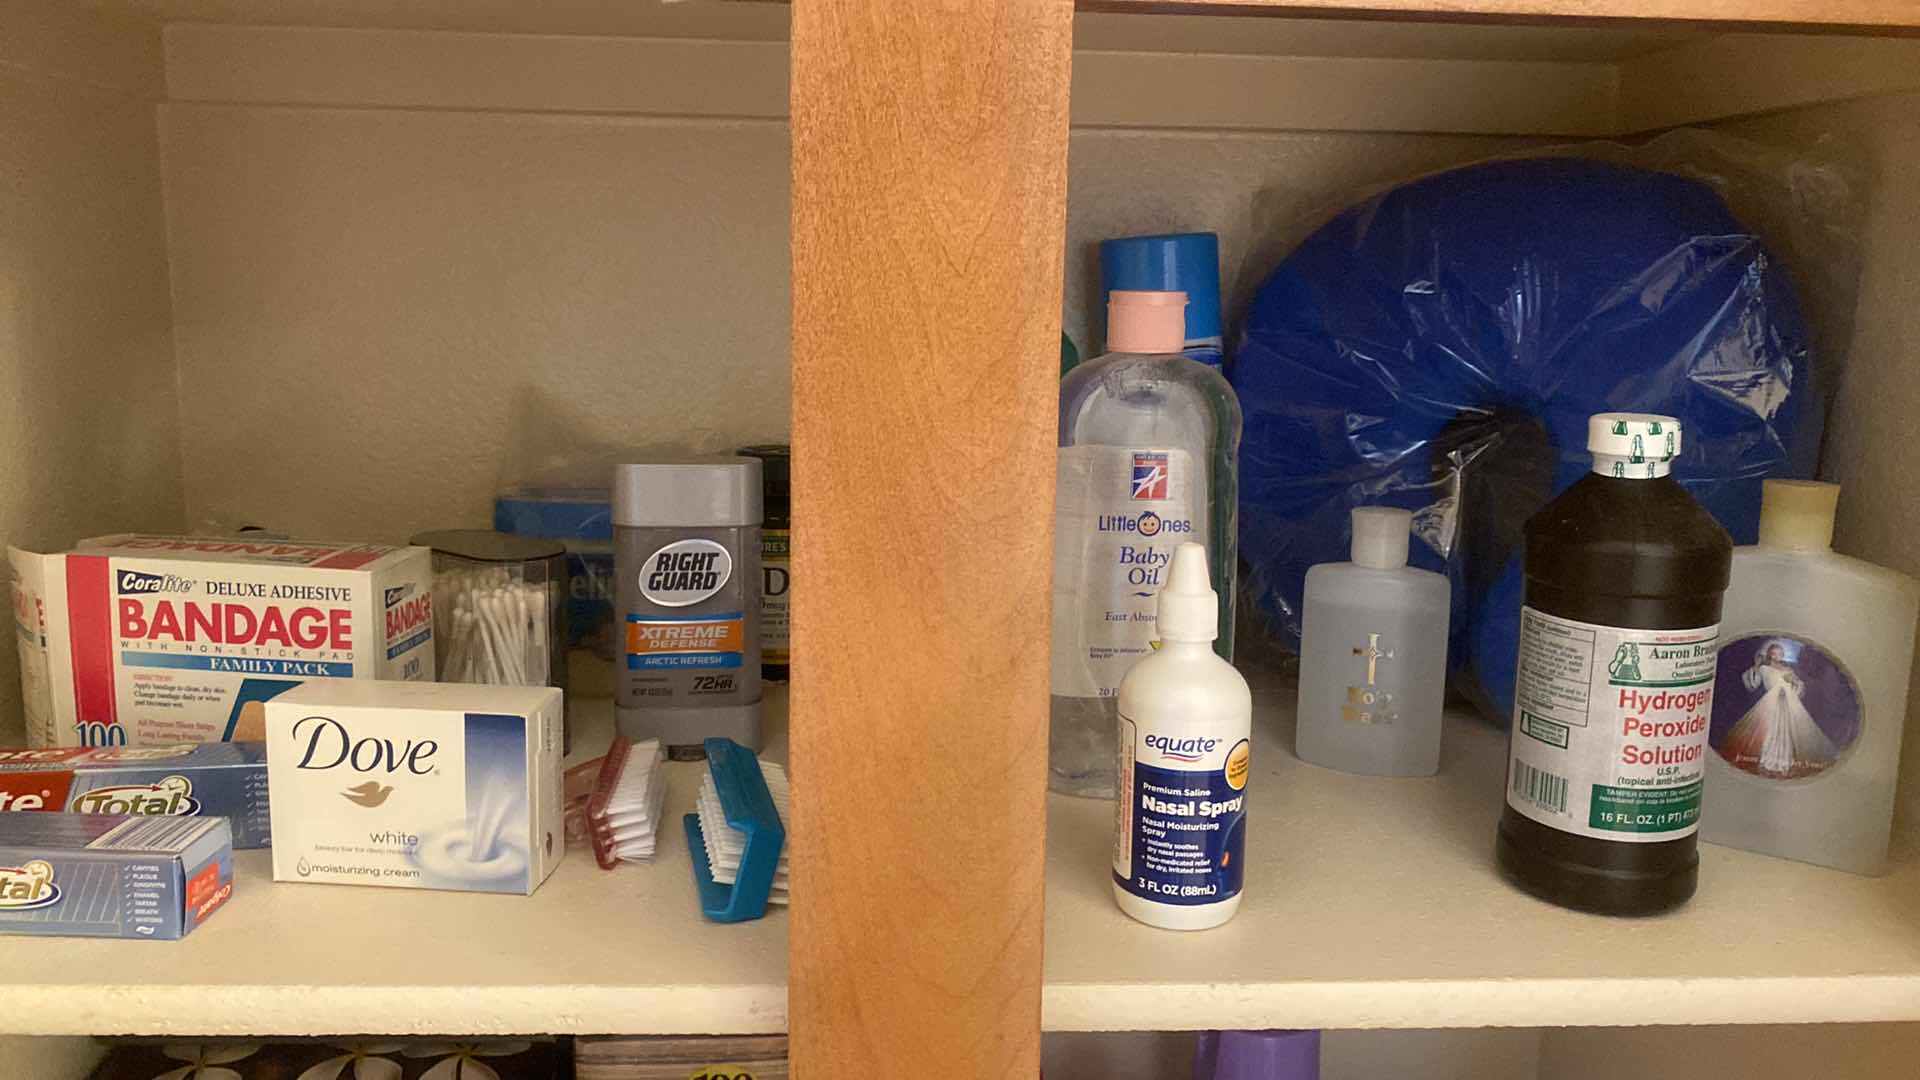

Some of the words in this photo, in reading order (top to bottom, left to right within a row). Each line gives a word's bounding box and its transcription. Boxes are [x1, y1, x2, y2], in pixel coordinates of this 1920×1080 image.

[655, 552, 720, 571] RIGHT
[1119, 546, 1170, 569] Baby
[648, 571, 718, 591] GUARD
[1127, 568, 1160, 585] Oil
[121, 572, 193, 594] Coralite
[206, 581, 266, 598] DELUXE
[271, 585, 351, 602] ADHESIVE
[118, 598, 352, 650] BANDAGE
[1105, 611, 1127, 622] Fast
[640, 625, 729, 640] XTREME
[120, 641, 168, 652] WITH
[185, 644, 301, 658] NON-STICK
[319, 651, 354, 661] PAD
[649, 639, 718, 649] DEFENSE
[1648, 647, 1690, 659] Aaron
[210, 658, 279, 674] FAMILY
[286, 661, 330, 677] PACK
[645, 656, 679, 665] ARCTIC
[681, 655, 722, 665] REFRESH
[1618, 688, 1711, 714] Hydrogen
[1623, 716, 1706, 737] Peroxide
[292, 716, 439, 776] Dove
[1144, 734, 1216, 755] equate
[1622, 743, 1702, 765] Solution
[1656, 766, 1681, 777] U.S.P.
[1143, 782, 1182, 797] Premium
[1184, 788, 1211, 797] Saline
[1617, 776, 1654, 787] (topical
[1606, 788, 1638, 798] TAMPER
[80, 792, 182, 816] Total
[1142, 794, 1195, 817] Nasal
[1199, 795, 1243, 818] Spray
[1142, 817, 1165, 829] Nasal
[1167, 821, 1220, 832] Moisturizing
[1600, 811, 1614, 822] 16
[1616, 813, 1634, 825] FL.
[1656, 814, 1666, 826] (1
[1667, 811, 1682, 824] PT)
[369, 831, 418, 846] white
[1142, 826, 1166, 839] Spray
[312, 863, 380, 877] moisturizing
[384, 867, 420, 878] cream
[1138, 876, 1145, 888] 3
[1147, 880, 1161, 893] FL
[1162, 884, 1179, 896] OZ
[1180, 884, 1217, 898] (88mL)
